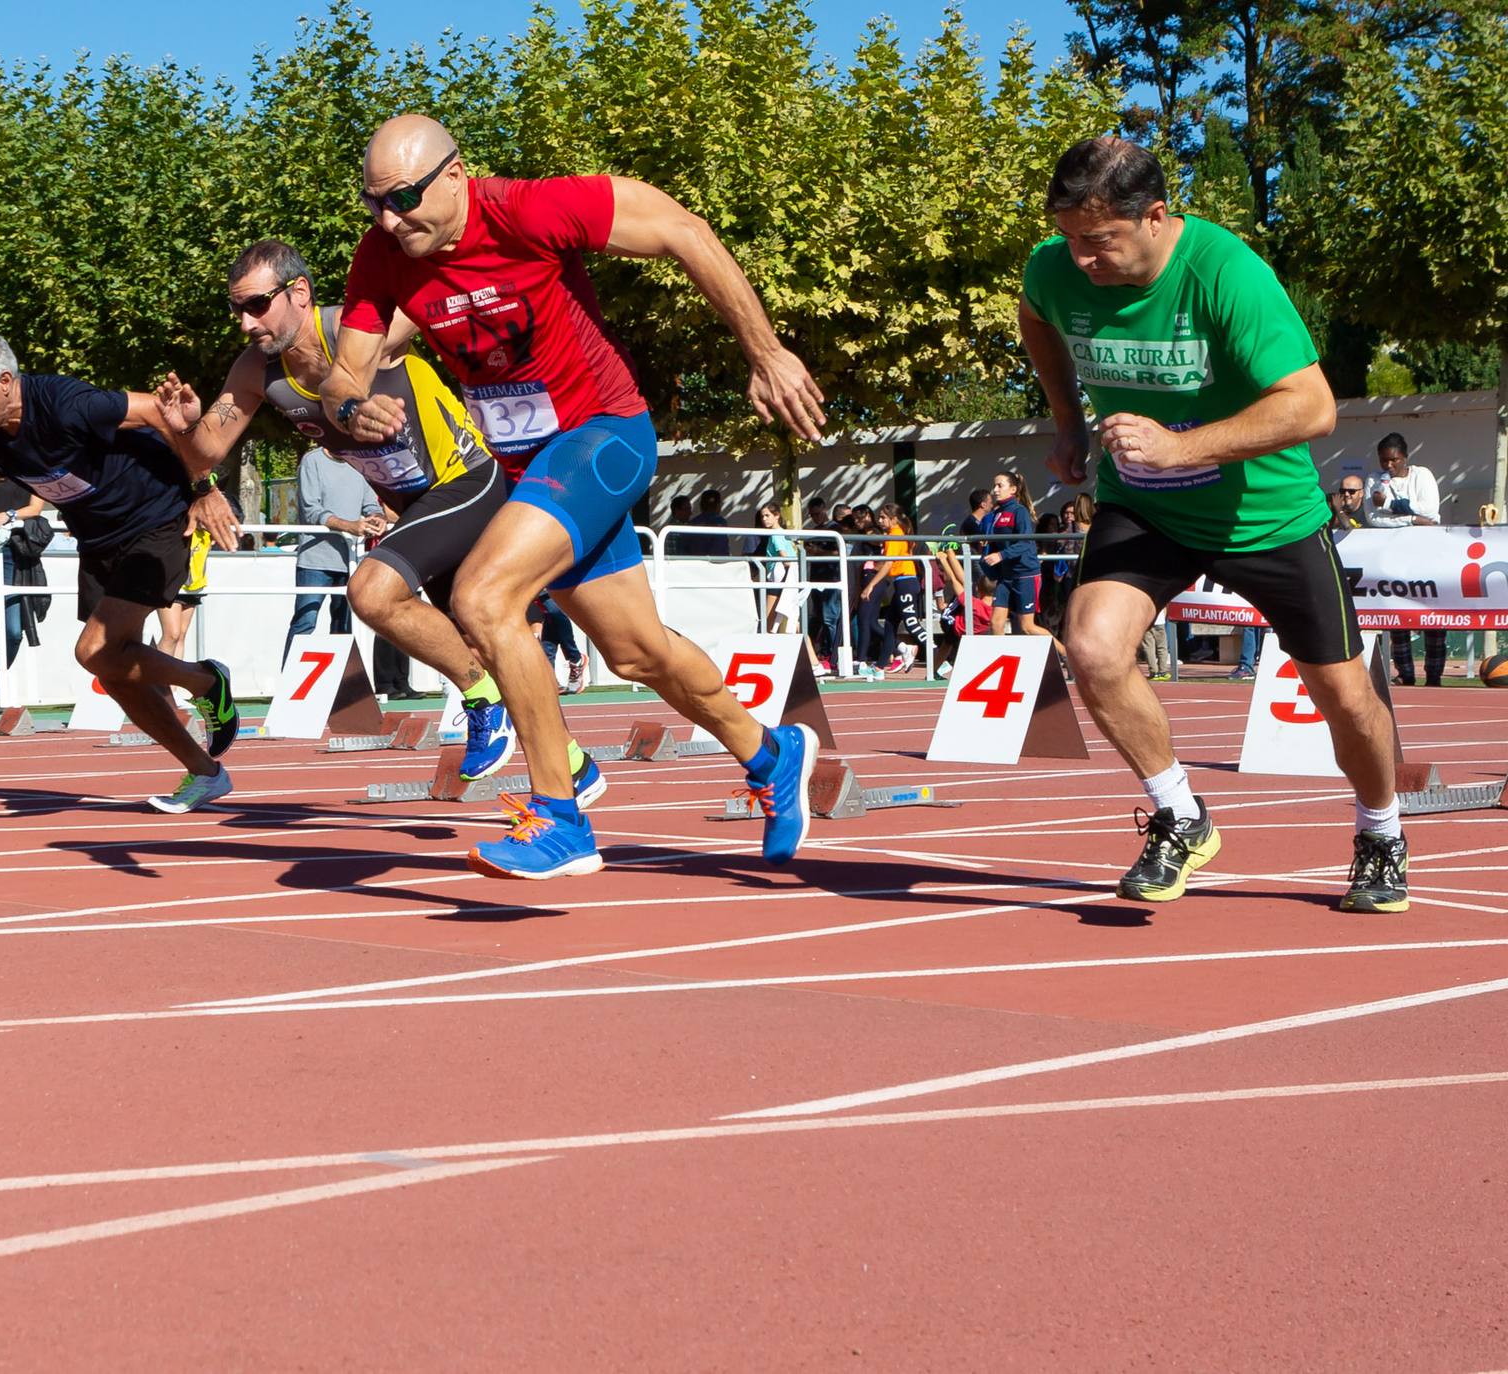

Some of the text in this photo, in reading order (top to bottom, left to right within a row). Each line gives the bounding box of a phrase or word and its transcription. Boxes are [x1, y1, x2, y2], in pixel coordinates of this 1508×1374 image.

[1072, 343, 1195, 367] CAJA RURAL
[477, 383, 540, 400] HEMAFIX
[1078, 366, 1208, 386] EGUROS RGA
[900, 593, 937, 649] DIDAS
[1182, 607, 1254, 623] IMPLANTACIÓN
[1357, 614, 1401, 626] ORATIVA
[1420, 612, 1472, 626] RÓTULOS
[1479, 614, 1488, 626] Y
[1495, 614, 1508, 626] LU
[289, 651, 336, 701] 7
[724, 652, 776, 709] 5
[956, 654, 1025, 719] 4
